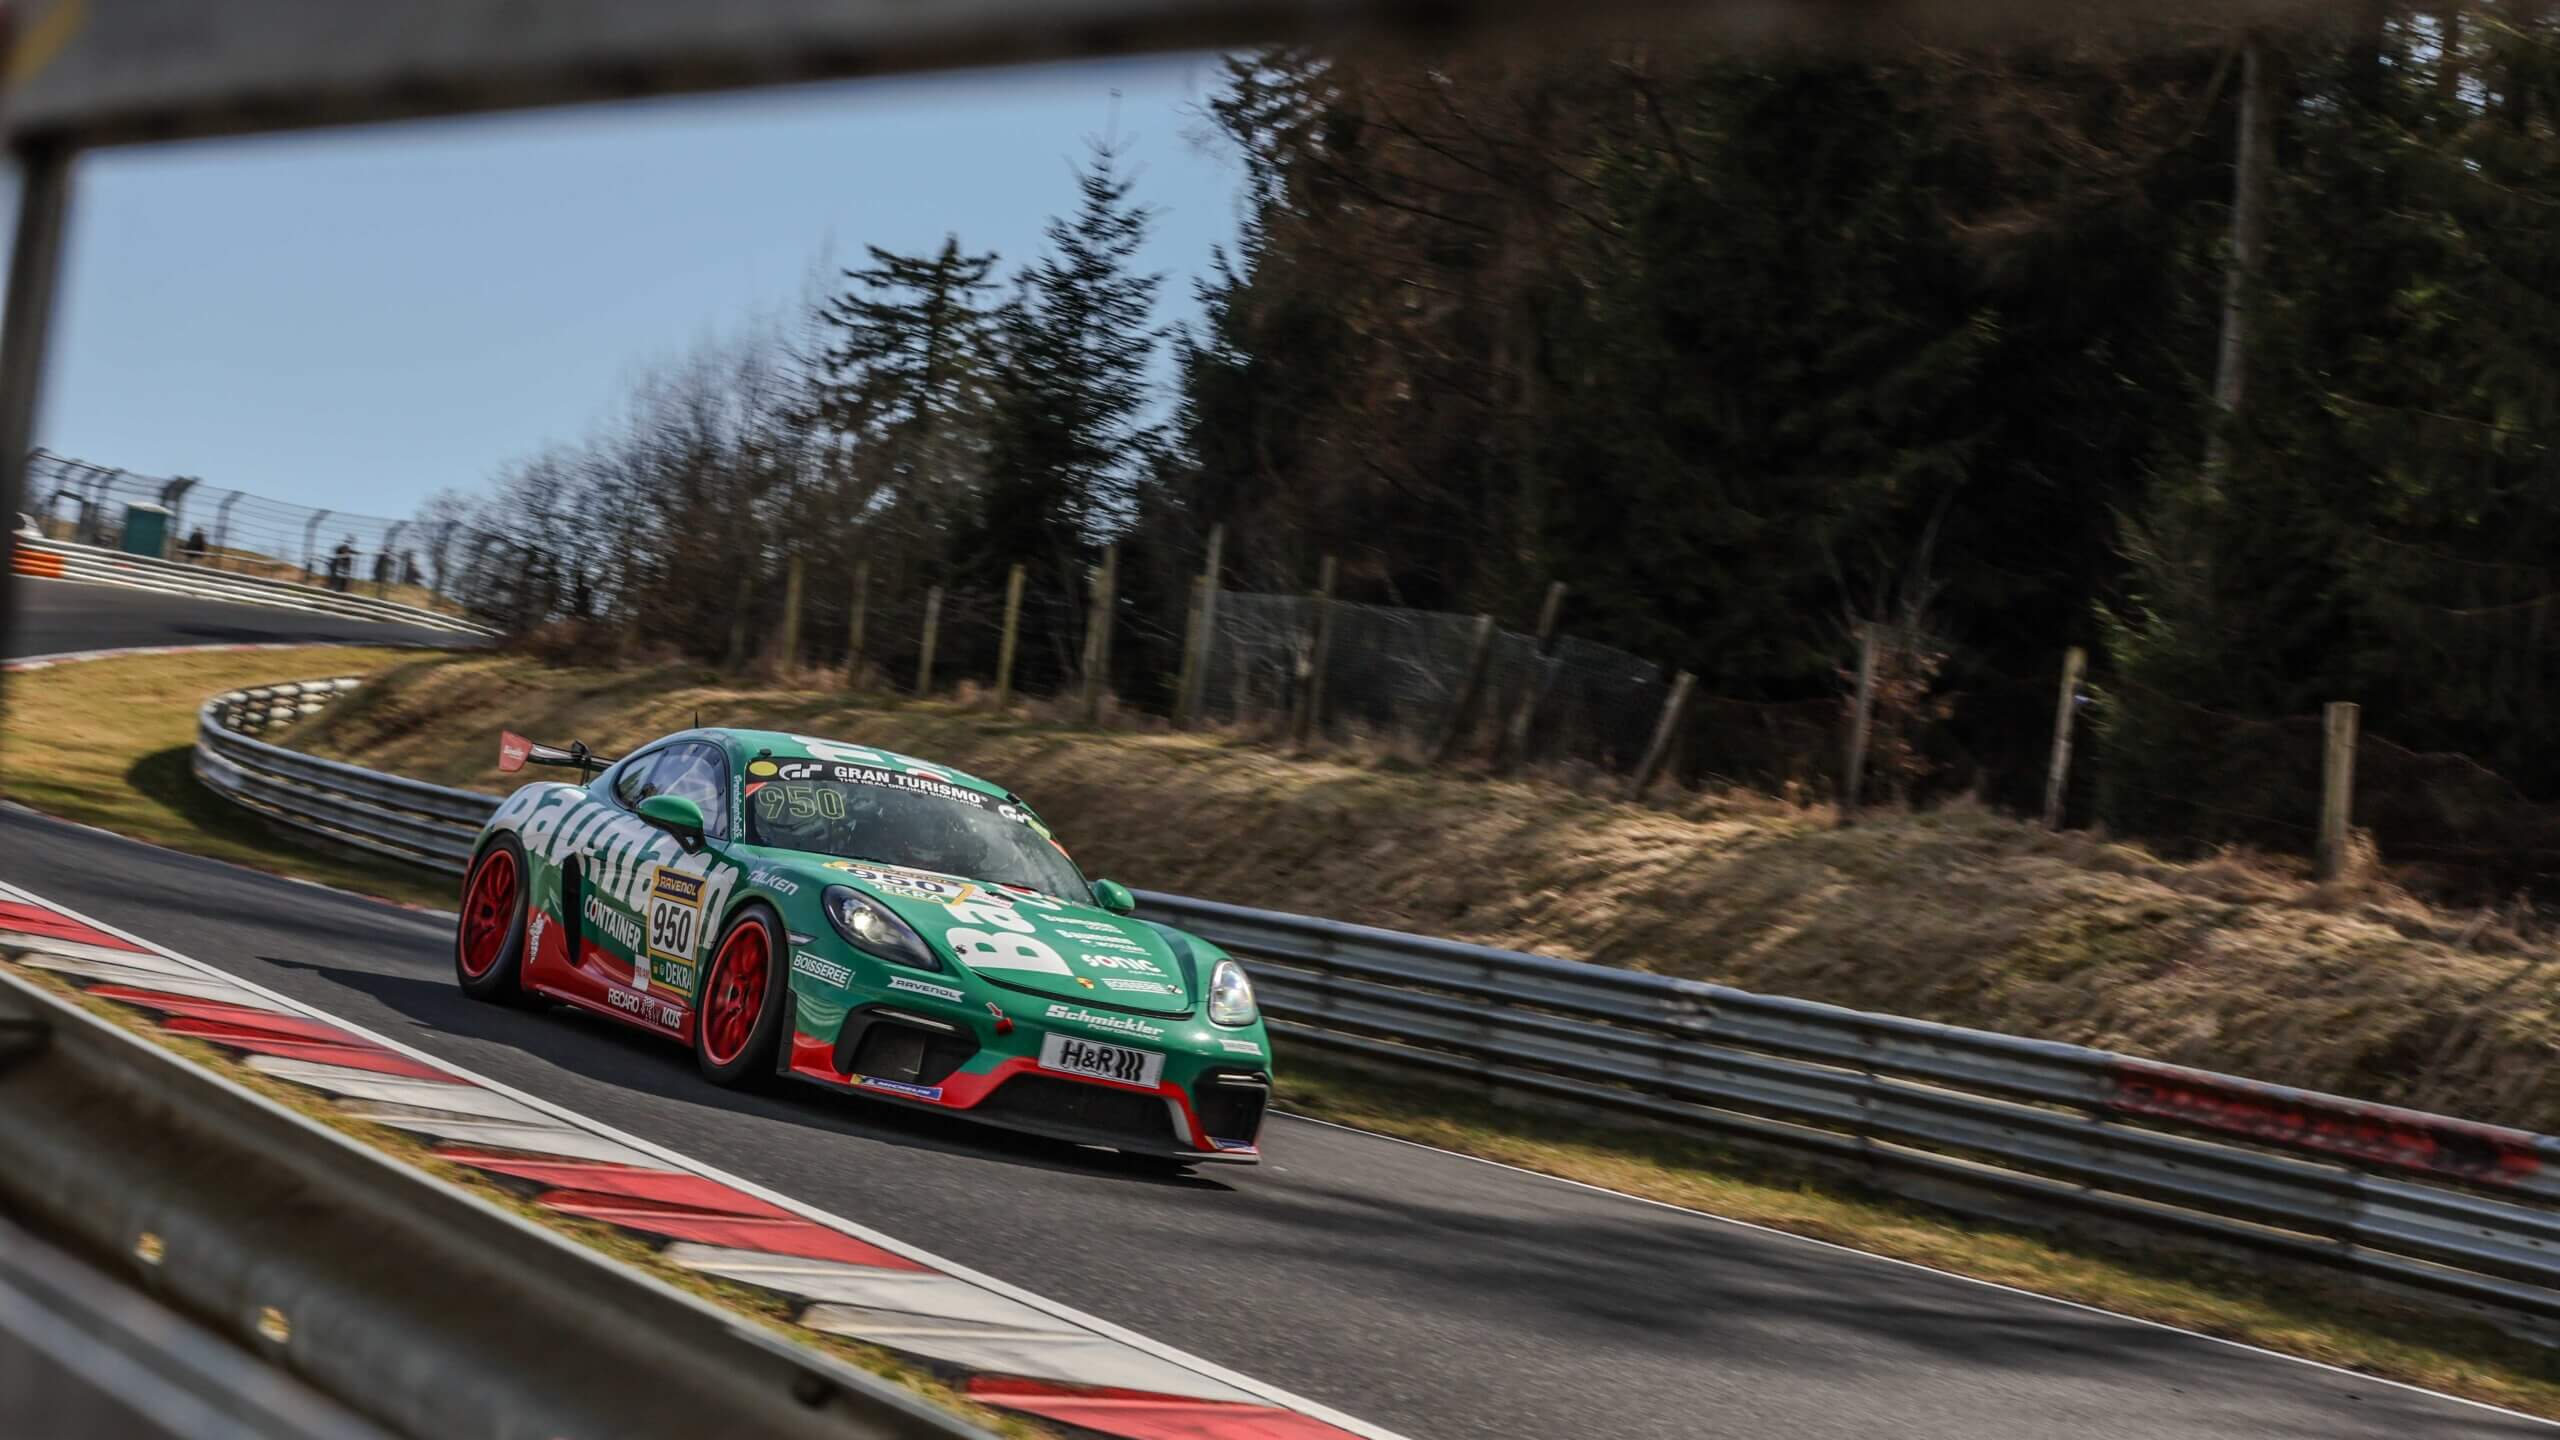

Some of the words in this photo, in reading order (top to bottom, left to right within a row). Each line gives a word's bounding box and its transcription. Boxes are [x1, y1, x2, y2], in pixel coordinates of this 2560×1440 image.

[834, 766, 890, 783] GRAN
[895, 774, 981, 804] TURISMO
[758, 783, 845, 820] 950
[659, 876, 697, 896] RAVENOL
[846, 868, 945, 893] 950
[584, 894, 641, 953] CONTAINER
[653, 902, 692, 953] 950
[665, 961, 692, 991] DEKRA
[896, 979, 957, 999] RAVENOL
[608, 988, 640, 1014] RECARO
[1045, 1004, 1165, 1036] Schmickler
[1060, 1040, 1113, 1073] H&R
